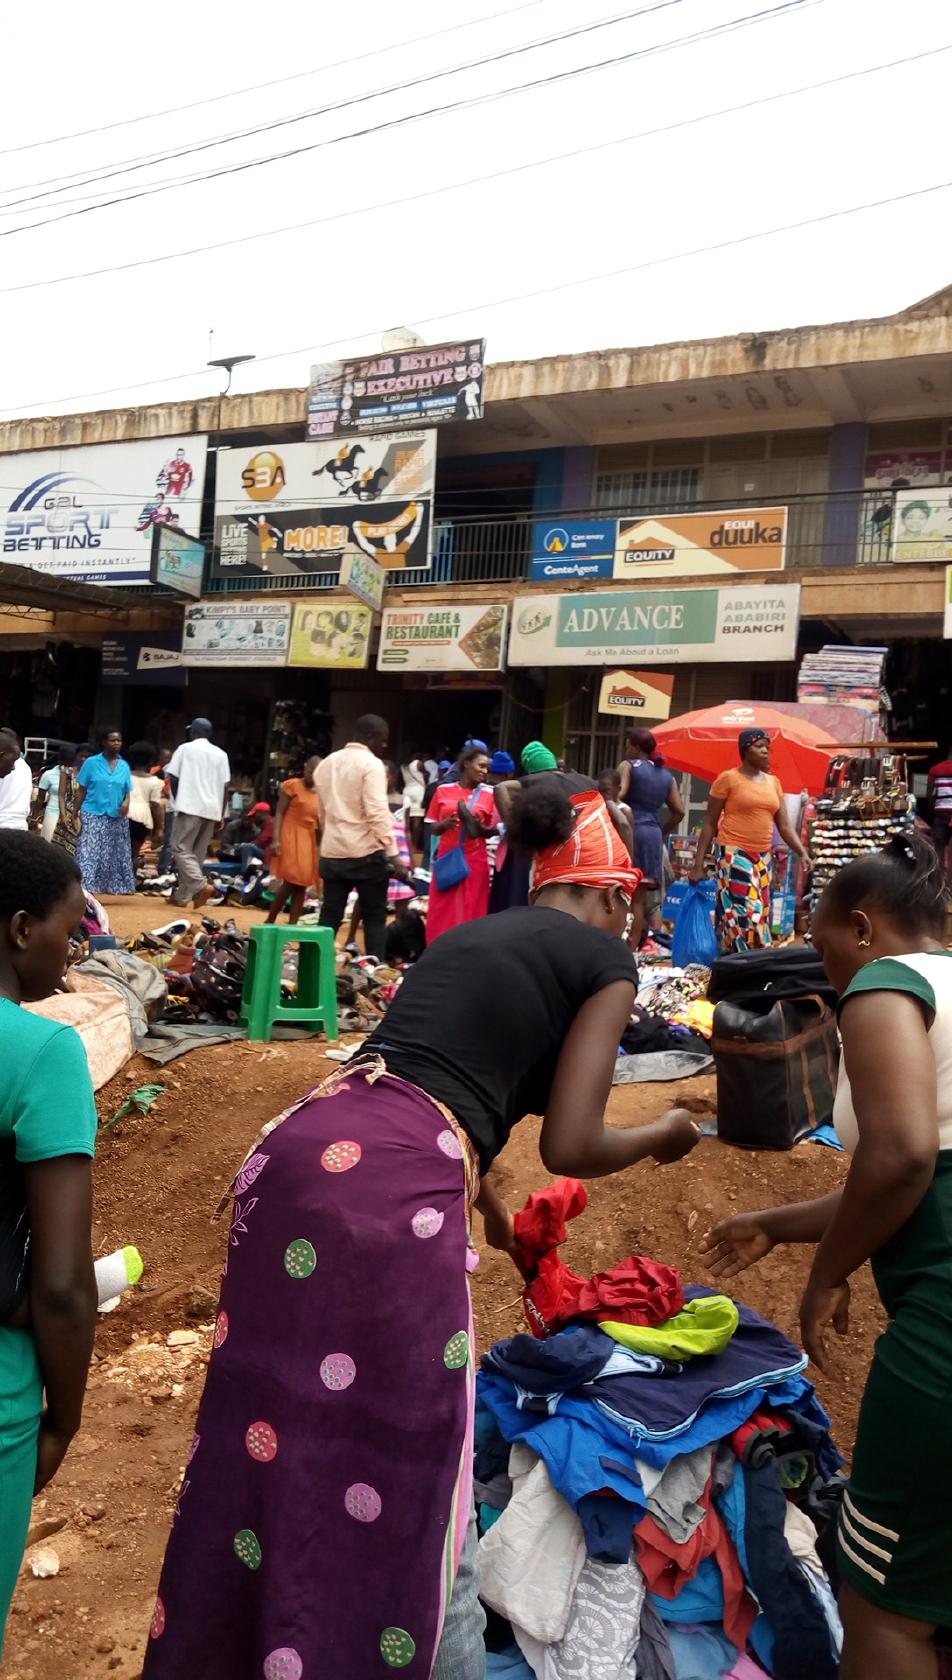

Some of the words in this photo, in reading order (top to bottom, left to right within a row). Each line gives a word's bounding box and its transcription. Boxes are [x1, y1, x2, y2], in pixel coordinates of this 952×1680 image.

[359, 357, 395, 377] FAIR
[399, 345, 466, 372] BETTING
[367, 367, 454, 396] EXECUTIVE
[5, 509, 119, 536] SPORT
[724, 520, 755, 530] EQUI
[222, 522, 248, 538] LIVE
[710, 521, 783, 547] duuka
[3, 534, 102, 552] BETTING
[284, 525, 350, 552] MORE!
[220, 554, 247, 566] HERE!
[626, 550, 673, 562] EQUITY
[57, 561, 77, 569] PAID
[544, 563, 599, 576] CenteAgent
[240, 605, 260, 614] BABY
[263, 604, 287, 614] POINT
[724, 599, 786, 611] ABAYITA
[387, 613, 426, 625] TRINITY
[427, 611, 452, 625] CAFÉ
[454, 612, 461, 624] &
[563, 604, 685, 633] ADVANCE
[724, 612, 786, 623] ABABIRI
[385, 624, 461, 640] RESTAURANT
[721, 624, 785, 635] BRANCH
[585, 648, 602, 656] Ask
[605, 647, 617, 656] Me
[619, 647, 646, 656] About
[648, 648, 654, 656] a
[656, 647, 679, 655] Loan
[608, 696, 645, 707] EQUITY
